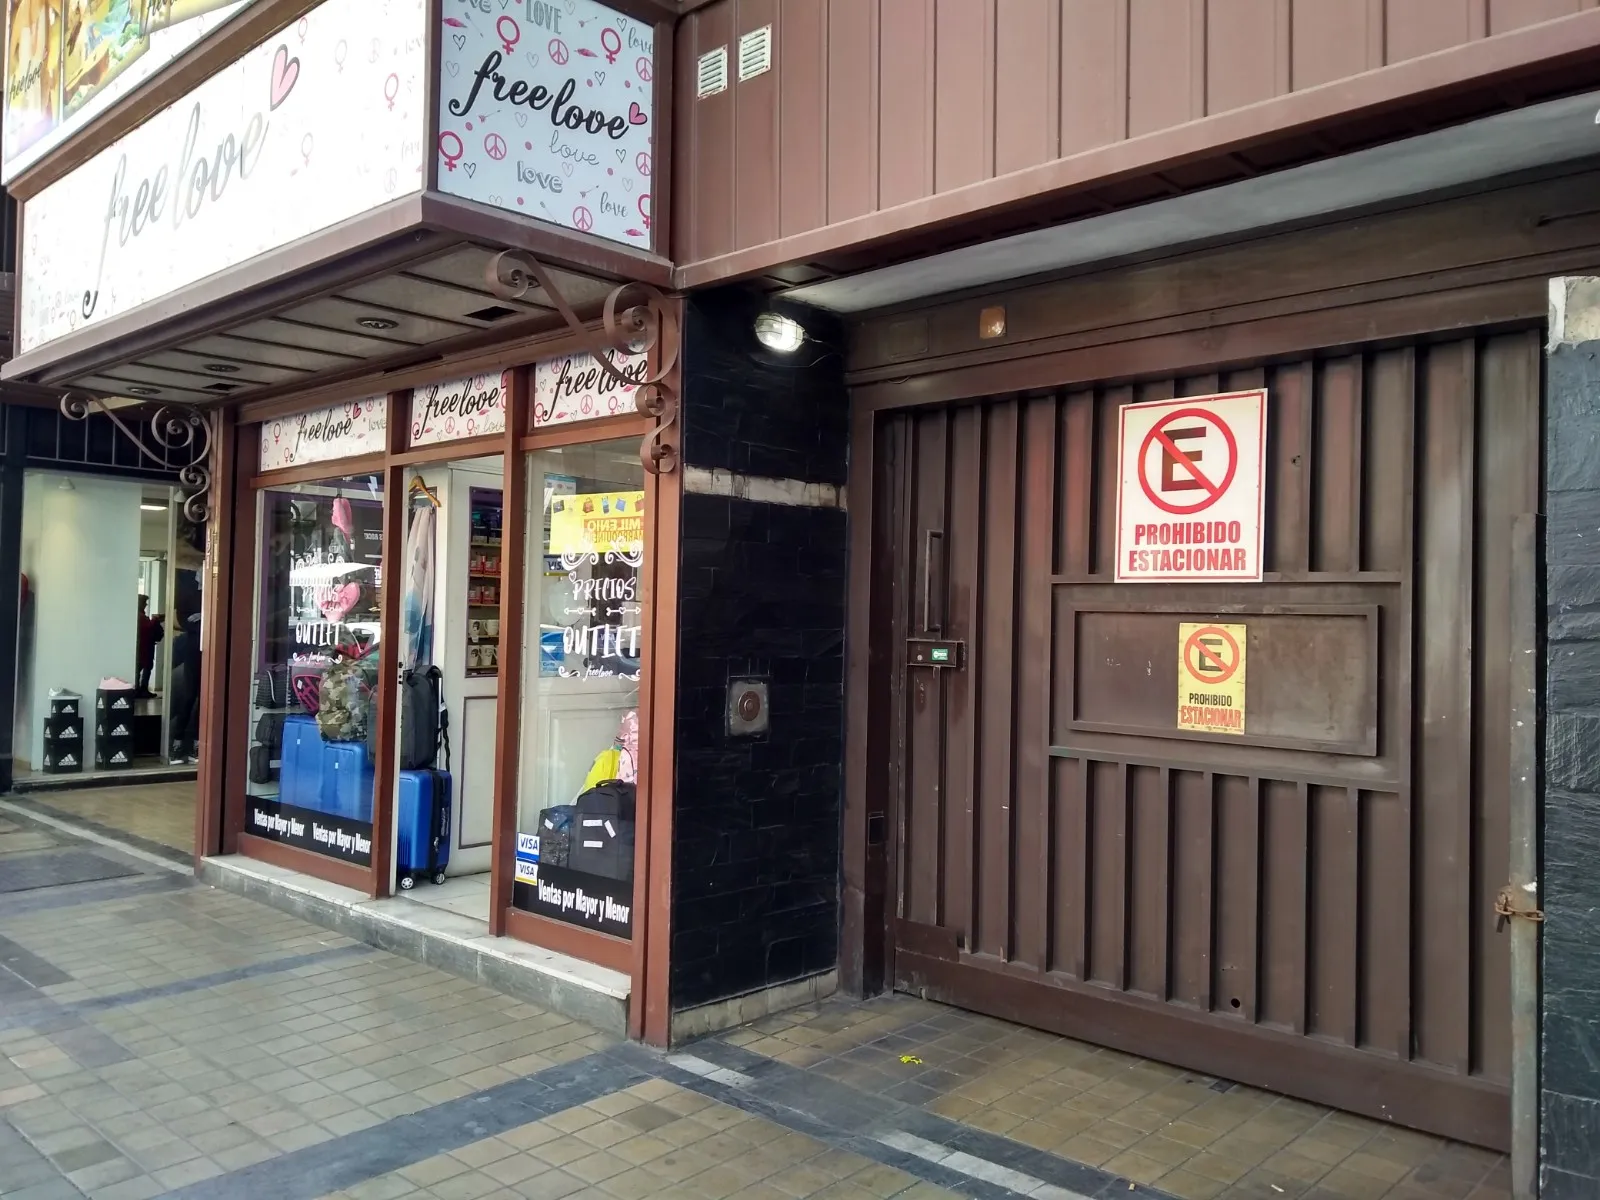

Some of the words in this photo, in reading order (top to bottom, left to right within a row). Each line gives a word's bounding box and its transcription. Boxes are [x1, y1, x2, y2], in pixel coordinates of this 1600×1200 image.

[526, 0, 562, 34] LOVE
[449, 50, 629, 139] freelove
[549, 130, 600, 165] love
[517, 161, 563, 193] love
[82, 102, 269, 319] freelove
[600, 192, 628, 217] love
[414, 377, 501, 440] freelove
[290, 408, 354, 462] freelove
[1135, 520, 1241, 545] PROHIBIDO
[1128, 548, 1246, 572] ESTACIONAR
[572, 576, 637, 602] PRECIOS
[296, 620, 344, 647] OUTLET
[563, 623, 642, 659] OUTLET
[1189, 692, 1232, 707] PROHIBIDO
[1180, 705, 1242, 729] ESTACIONAR
[254, 808, 268, 828] Ventas
[267, 815, 275, 832] por
[275, 813, 288, 836] Mayor
[291, 817, 305, 837] Menor
[312, 822, 328, 843] Ventas
[328, 830, 337, 848] por
[337, 828, 351, 853] Mayor
[355, 832, 371, 854] Menor
[519, 838, 538, 850] VISA
[519, 864, 535, 877] VISA
[538, 878, 562, 906] Ventas
[562, 889, 576, 912] por
[576, 887, 598, 919] Mayor
[598, 899, 605, 923] y
[605, 895, 630, 924] Menor
